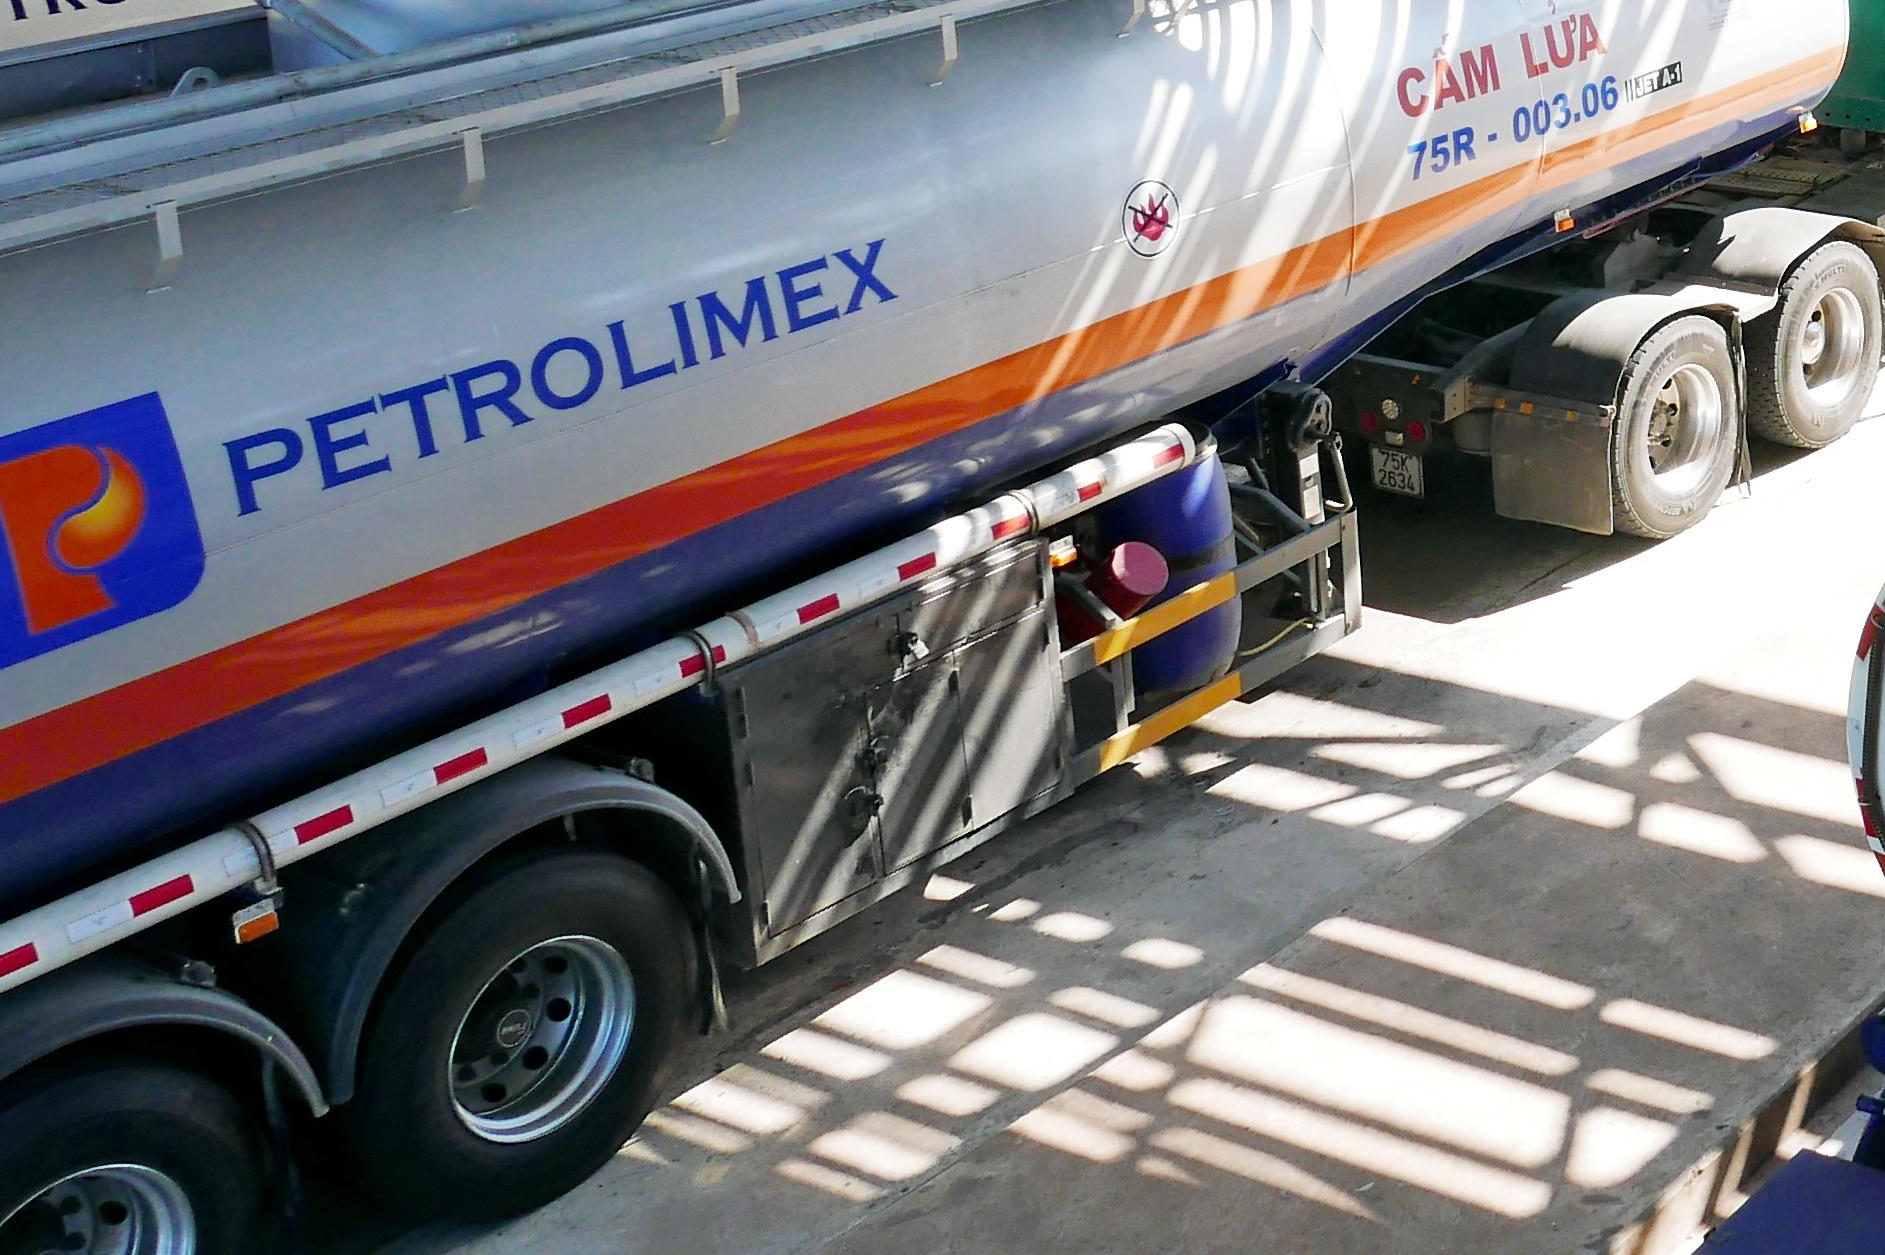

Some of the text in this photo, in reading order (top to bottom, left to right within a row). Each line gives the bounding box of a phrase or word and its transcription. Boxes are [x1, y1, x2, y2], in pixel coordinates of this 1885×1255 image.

[1396, 33, 1501, 118] CẤM
[1519, 0, 1608, 79] LỬA
[1407, 126, 1476, 181] 75R
[1512, 75, 1619, 144] 003.06
[222, 238, 898, 517] PETROLIMEX
[1379, 468, 1415, 492] 2634
